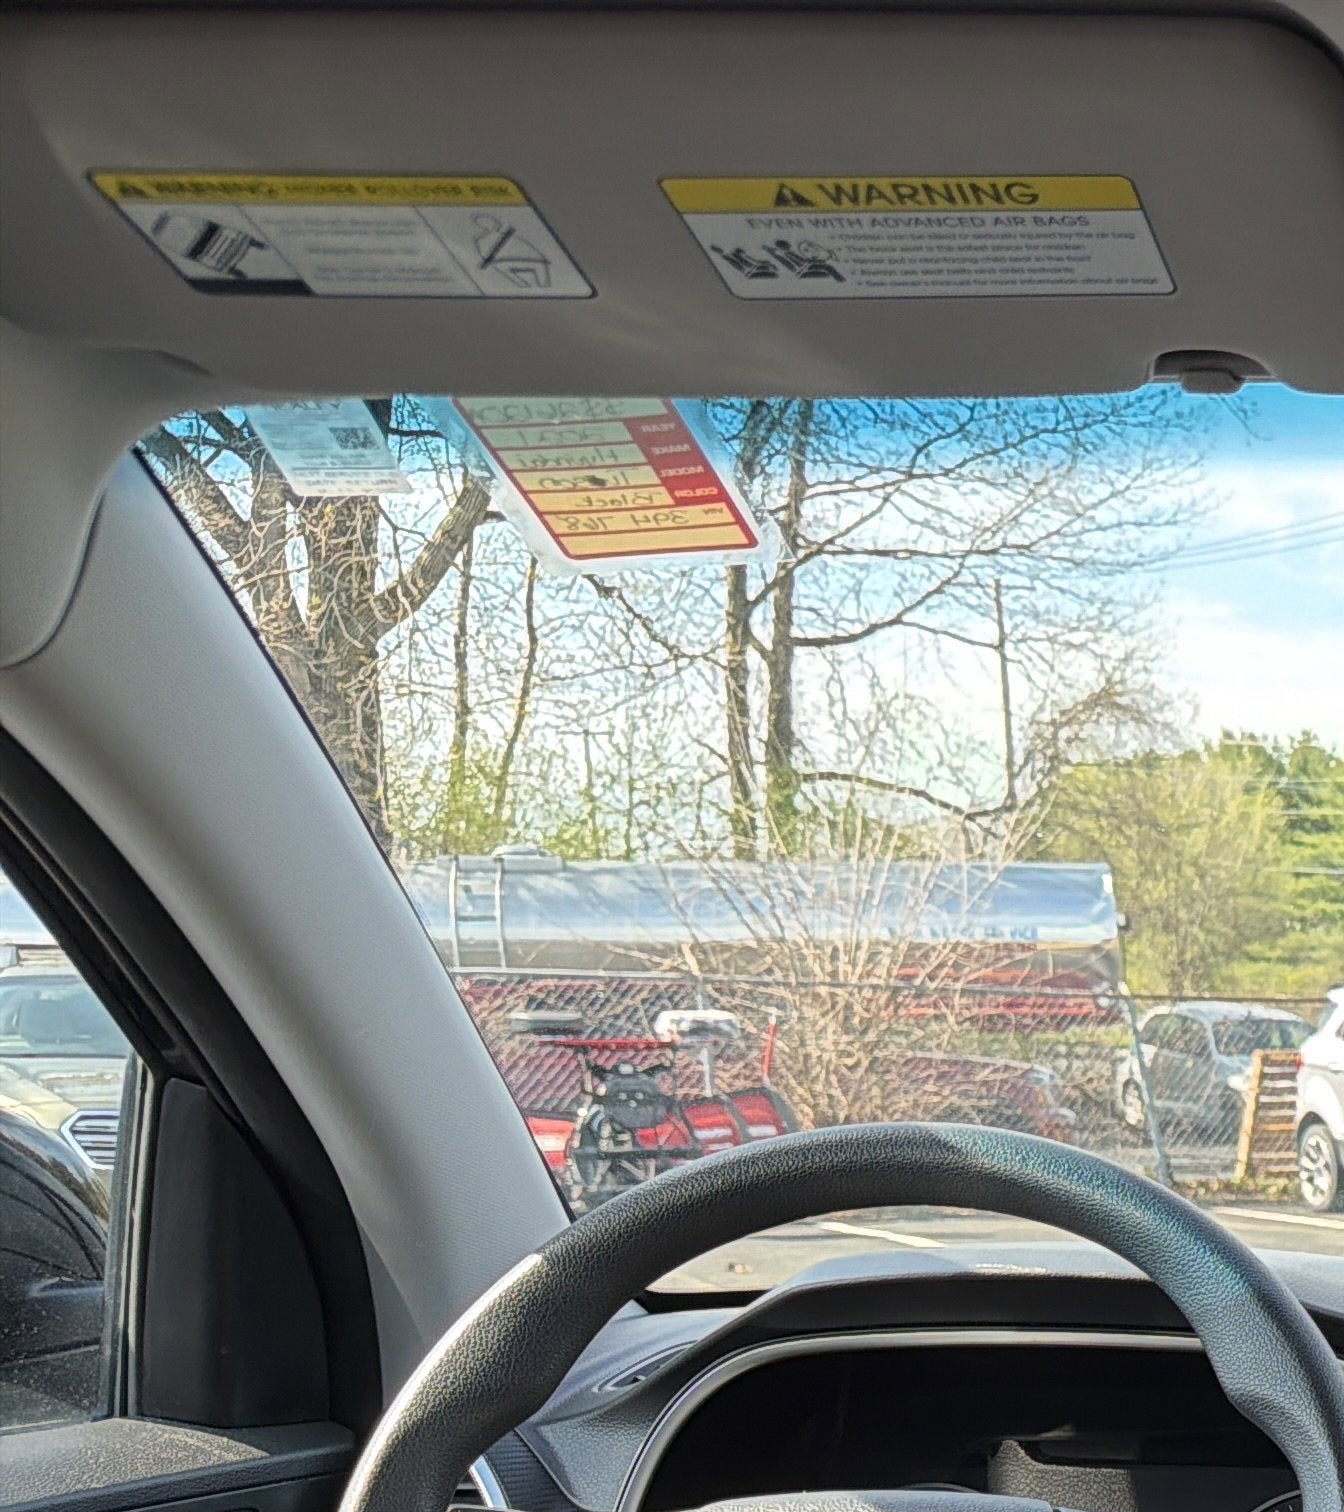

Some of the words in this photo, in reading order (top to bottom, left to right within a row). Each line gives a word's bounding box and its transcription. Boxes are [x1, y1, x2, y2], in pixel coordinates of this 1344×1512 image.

[817, 182, 1040, 207] WARNING
[747, 218, 799, 229] EVEN
[808, 218, 863, 229] WITH
[870, 216, 986, 229] ADVANCED
[993, 216, 1026, 227] AIR
[1033, 215, 1090, 227] BAGS
